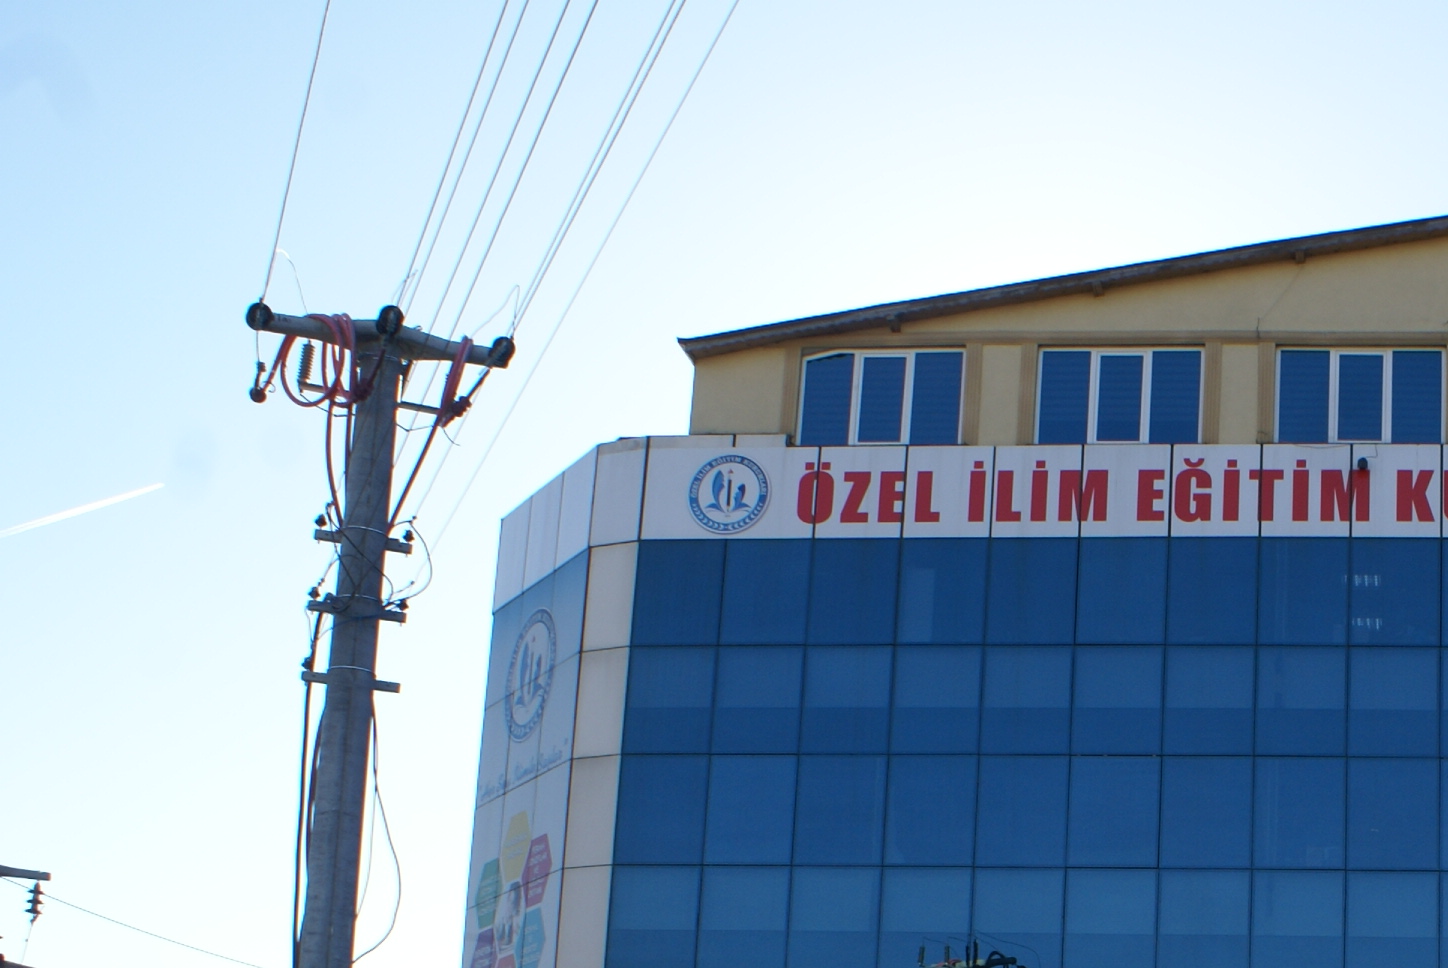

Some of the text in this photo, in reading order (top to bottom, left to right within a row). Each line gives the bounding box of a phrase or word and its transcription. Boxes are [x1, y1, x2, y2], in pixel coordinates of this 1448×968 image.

[797, 462, 940, 524] ÖZEL
[968, 460, 1108, 522] İLİM
[1137, 457, 1370, 522] EĞİTİM
